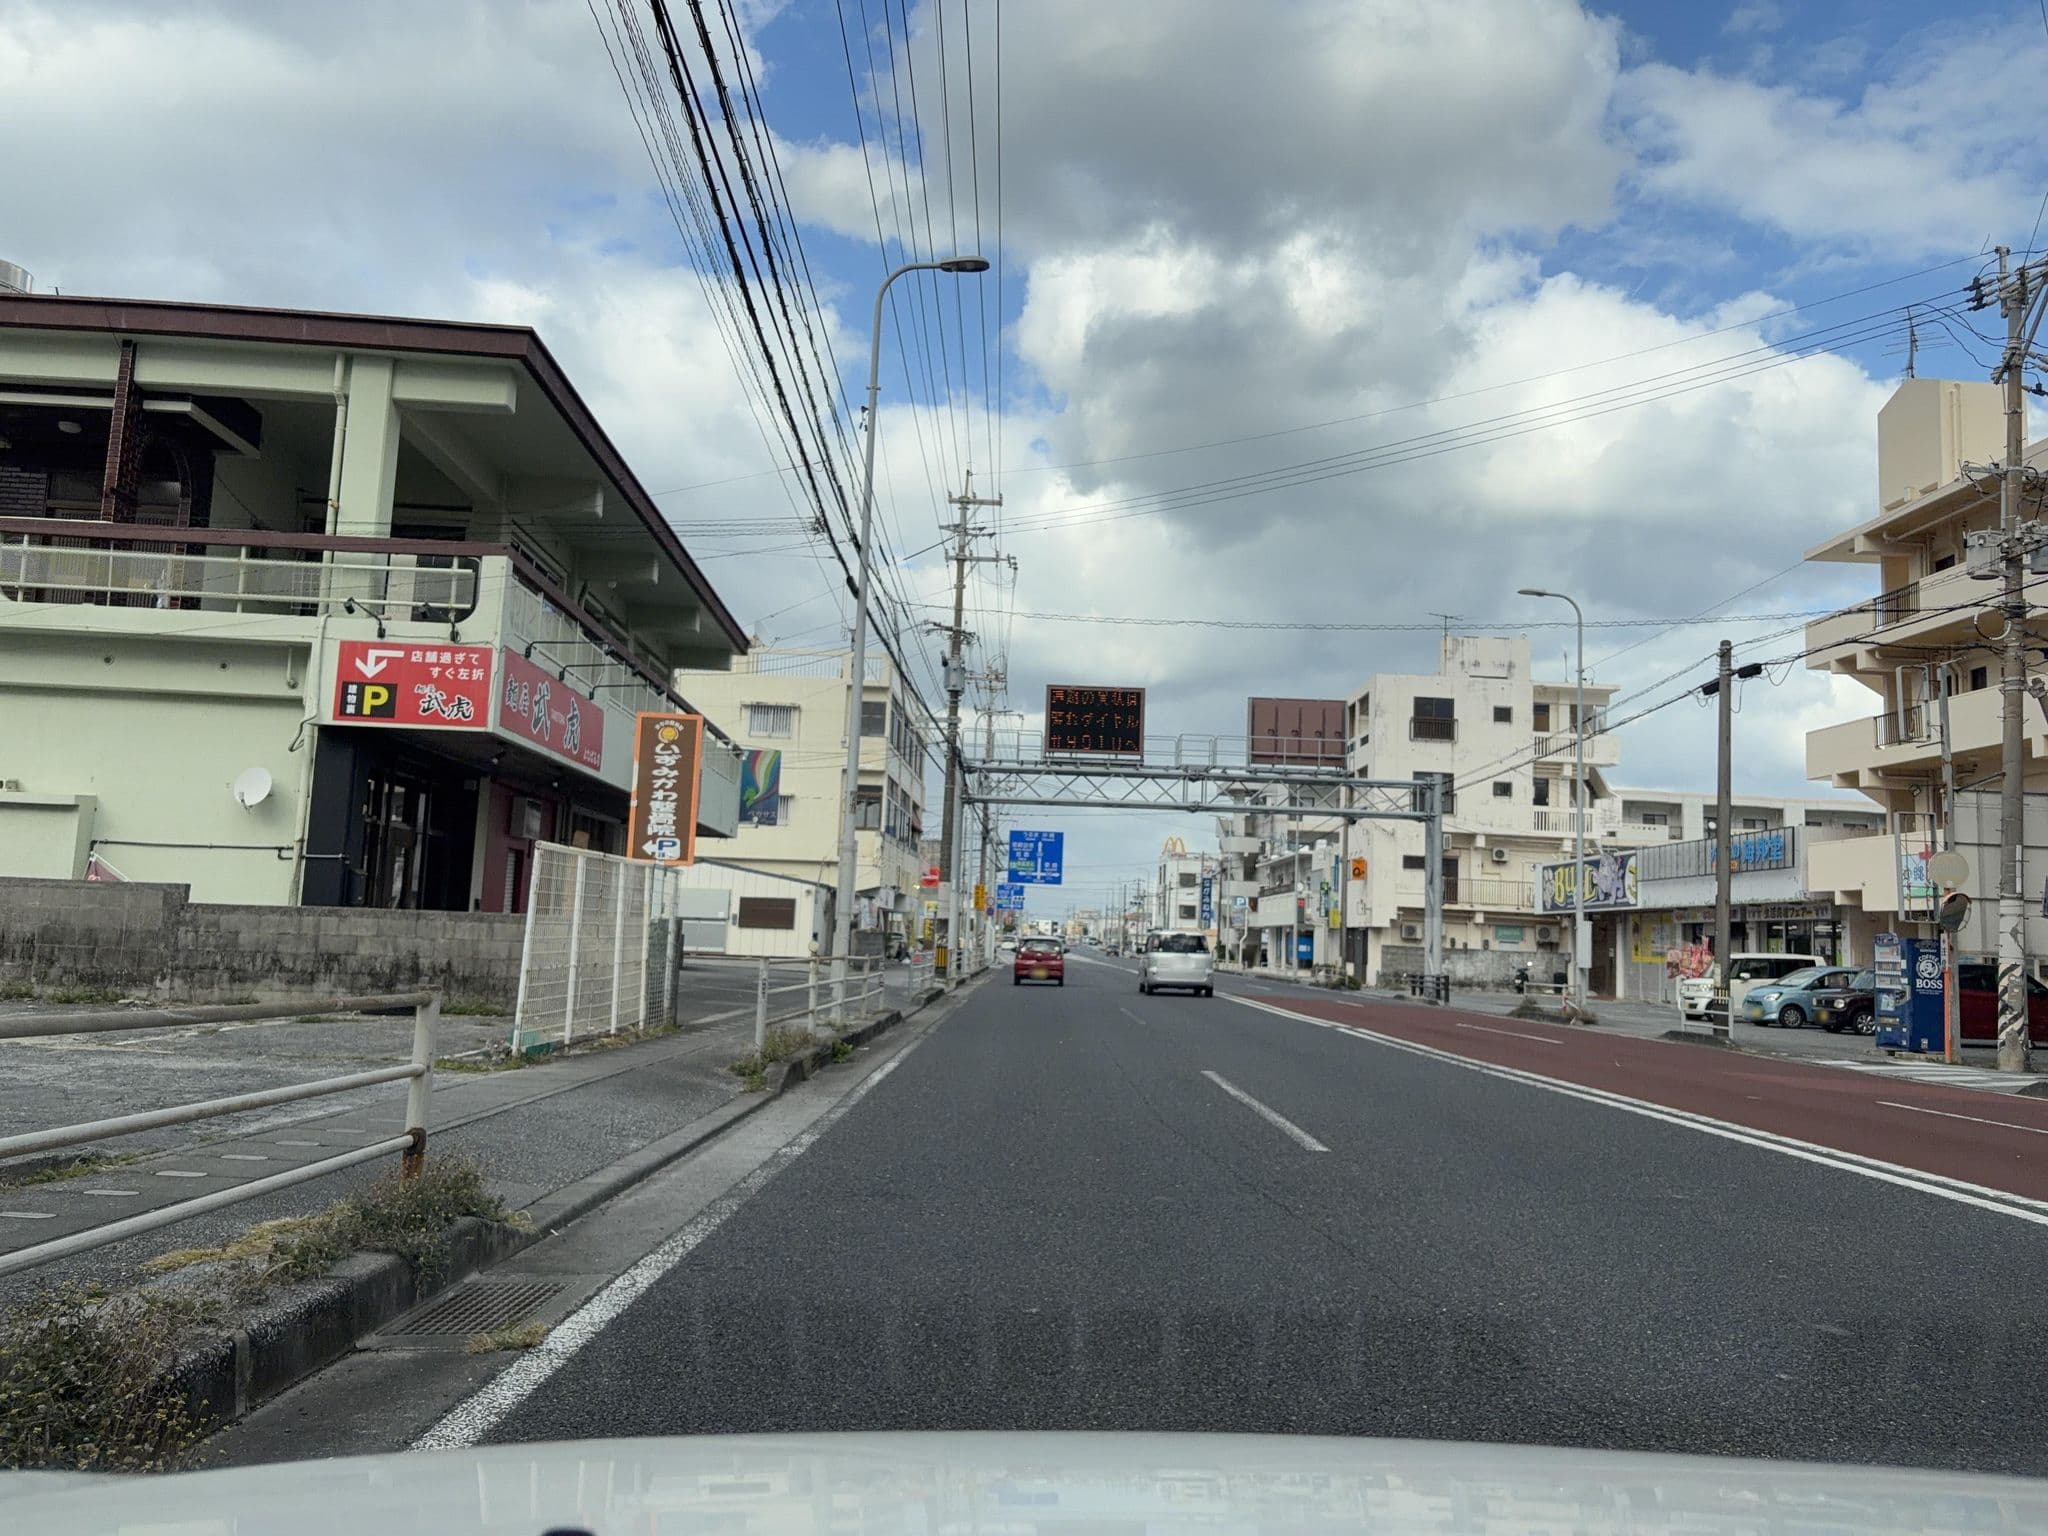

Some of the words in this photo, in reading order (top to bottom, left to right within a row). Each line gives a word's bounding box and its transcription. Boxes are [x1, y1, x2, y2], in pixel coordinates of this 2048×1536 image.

[411, 650, 481, 665] 店舗過ぎて
[429, 666, 485, 680] すぐ左折
[362, 685, 389, 715] P
[658, 840, 677, 850] P
[1915, 978, 1943, 989] BOSS
